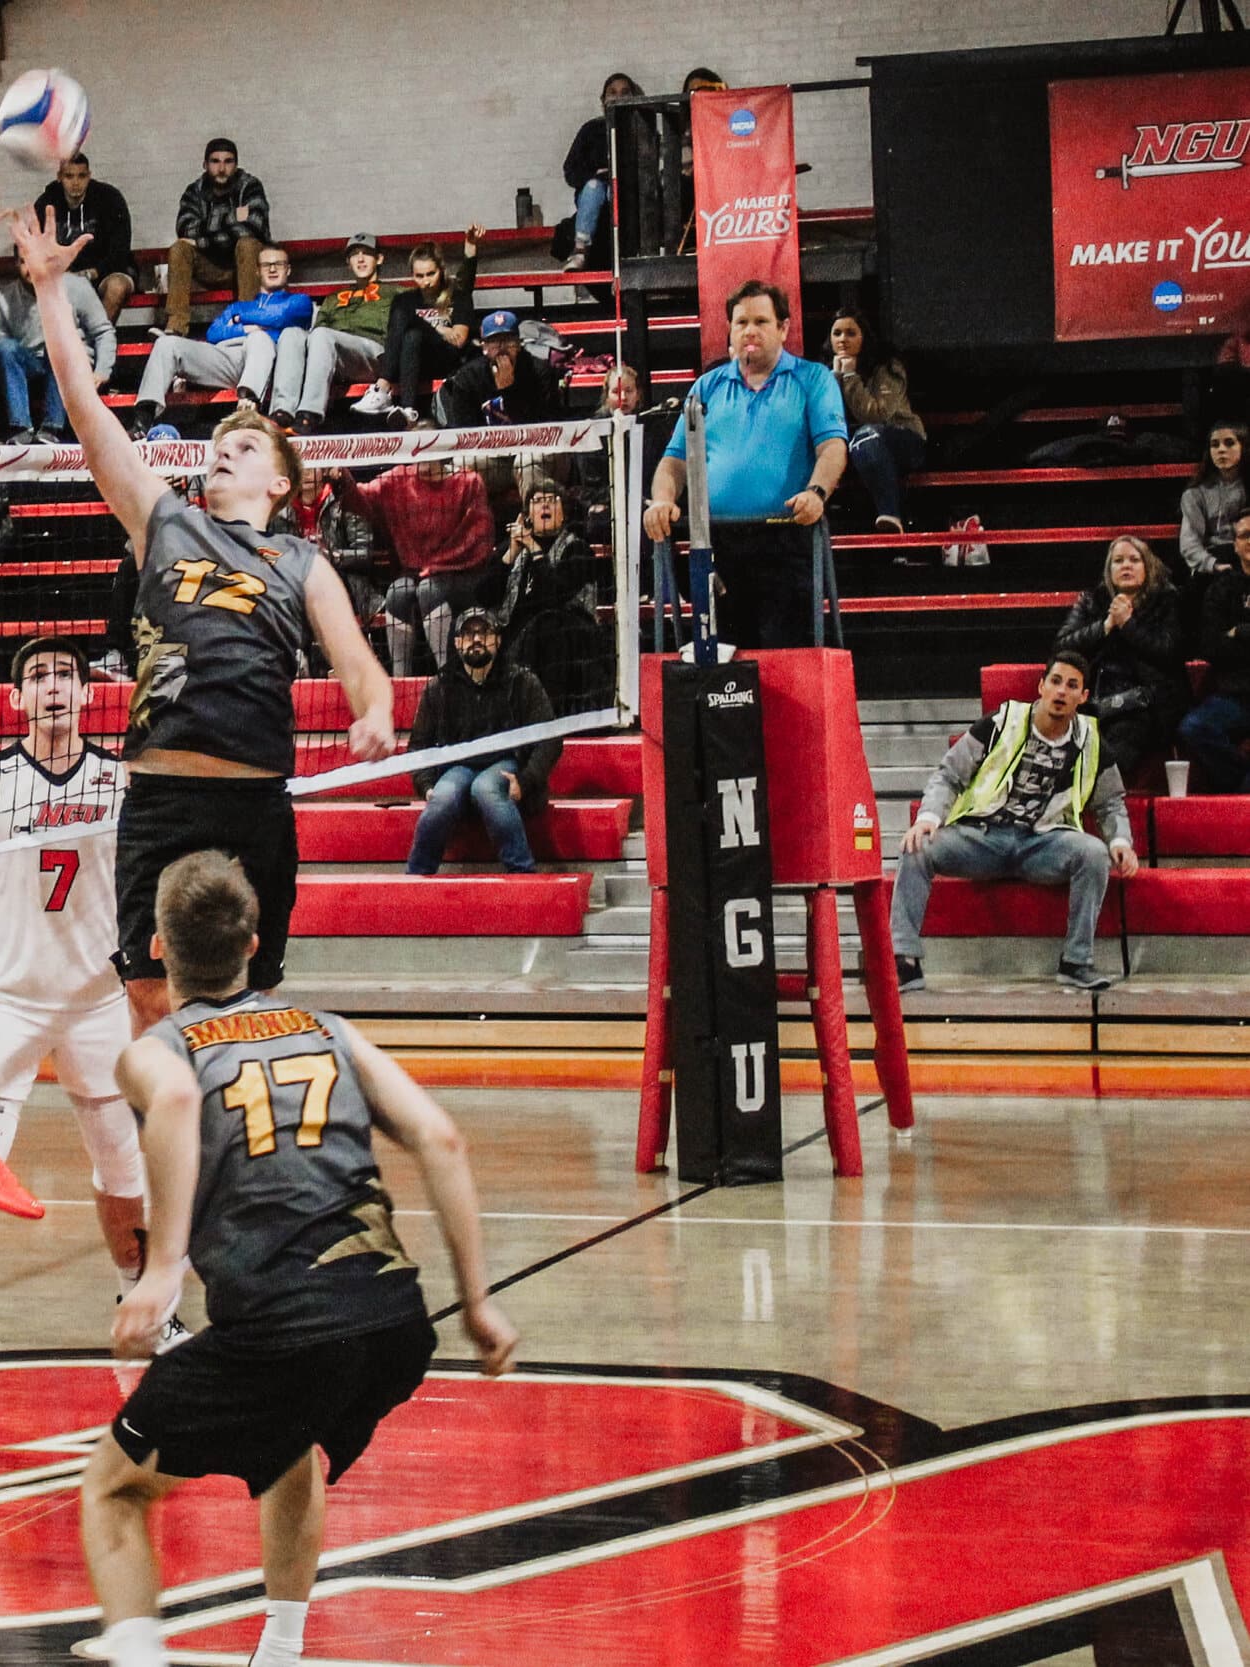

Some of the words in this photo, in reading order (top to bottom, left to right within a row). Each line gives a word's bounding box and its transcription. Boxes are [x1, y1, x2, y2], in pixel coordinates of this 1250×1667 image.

[1127, 118, 1250, 166] NGU
[734, 197, 775, 210] MAKE
[777, 194, 792, 208] IT
[700, 203, 791, 247] YOURS
[1070, 240, 1151, 267] MAKE
[1156, 239, 1184, 261] IT
[1155, 294, 1183, 305] NCAA
[150, 443, 205, 467] UNIVERSITY
[173, 557, 267, 616] 12
[707, 689, 754, 708] SPALDING
[33, 802, 108, 828] NGU
[40, 849, 80, 912] 7
[222, 1049, 340, 1160] 17
